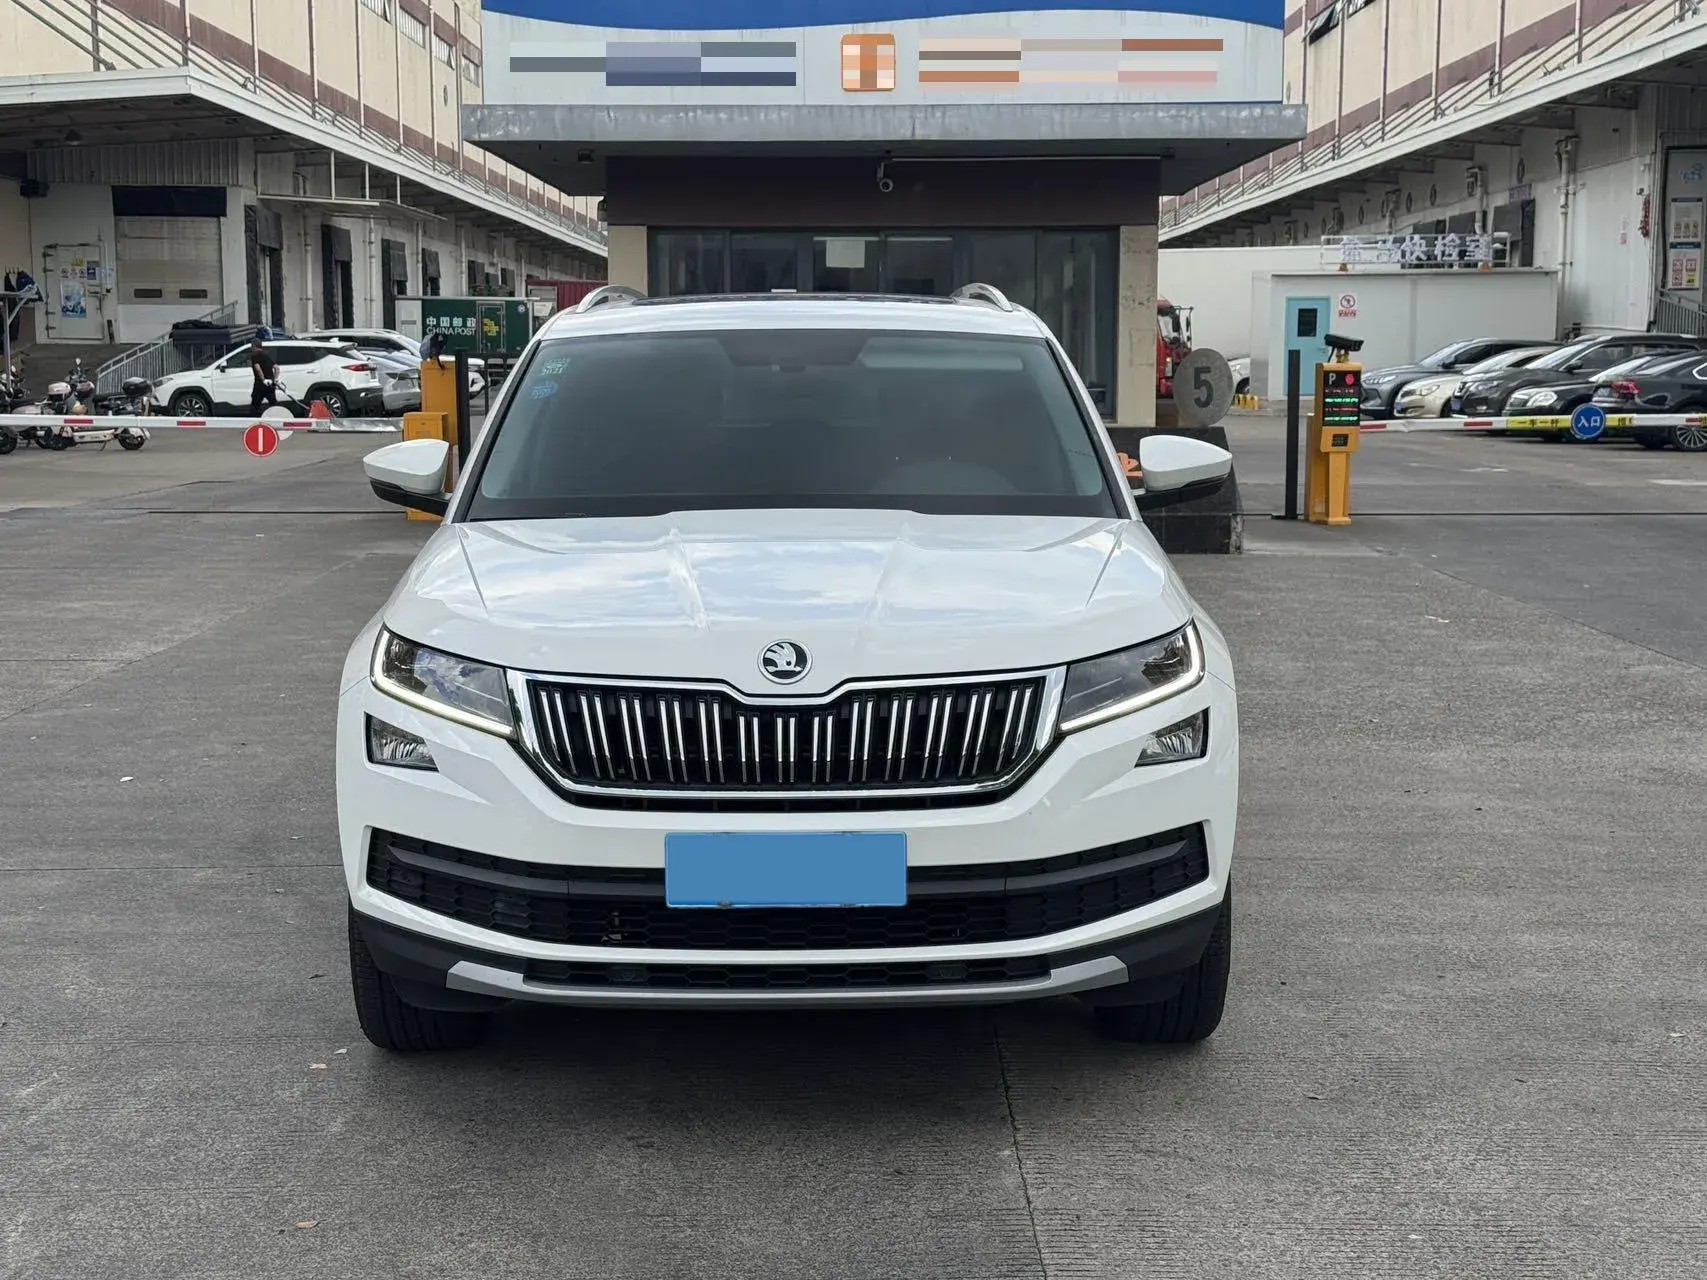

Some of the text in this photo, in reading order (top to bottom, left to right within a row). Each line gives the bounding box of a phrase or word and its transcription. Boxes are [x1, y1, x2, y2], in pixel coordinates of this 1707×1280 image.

[426, 316, 476, 327] 中国邮政
[1329, 373, 1336, 385] P
[1193, 366, 1214, 408] 5
[1578, 415, 1600, 428] 入口
